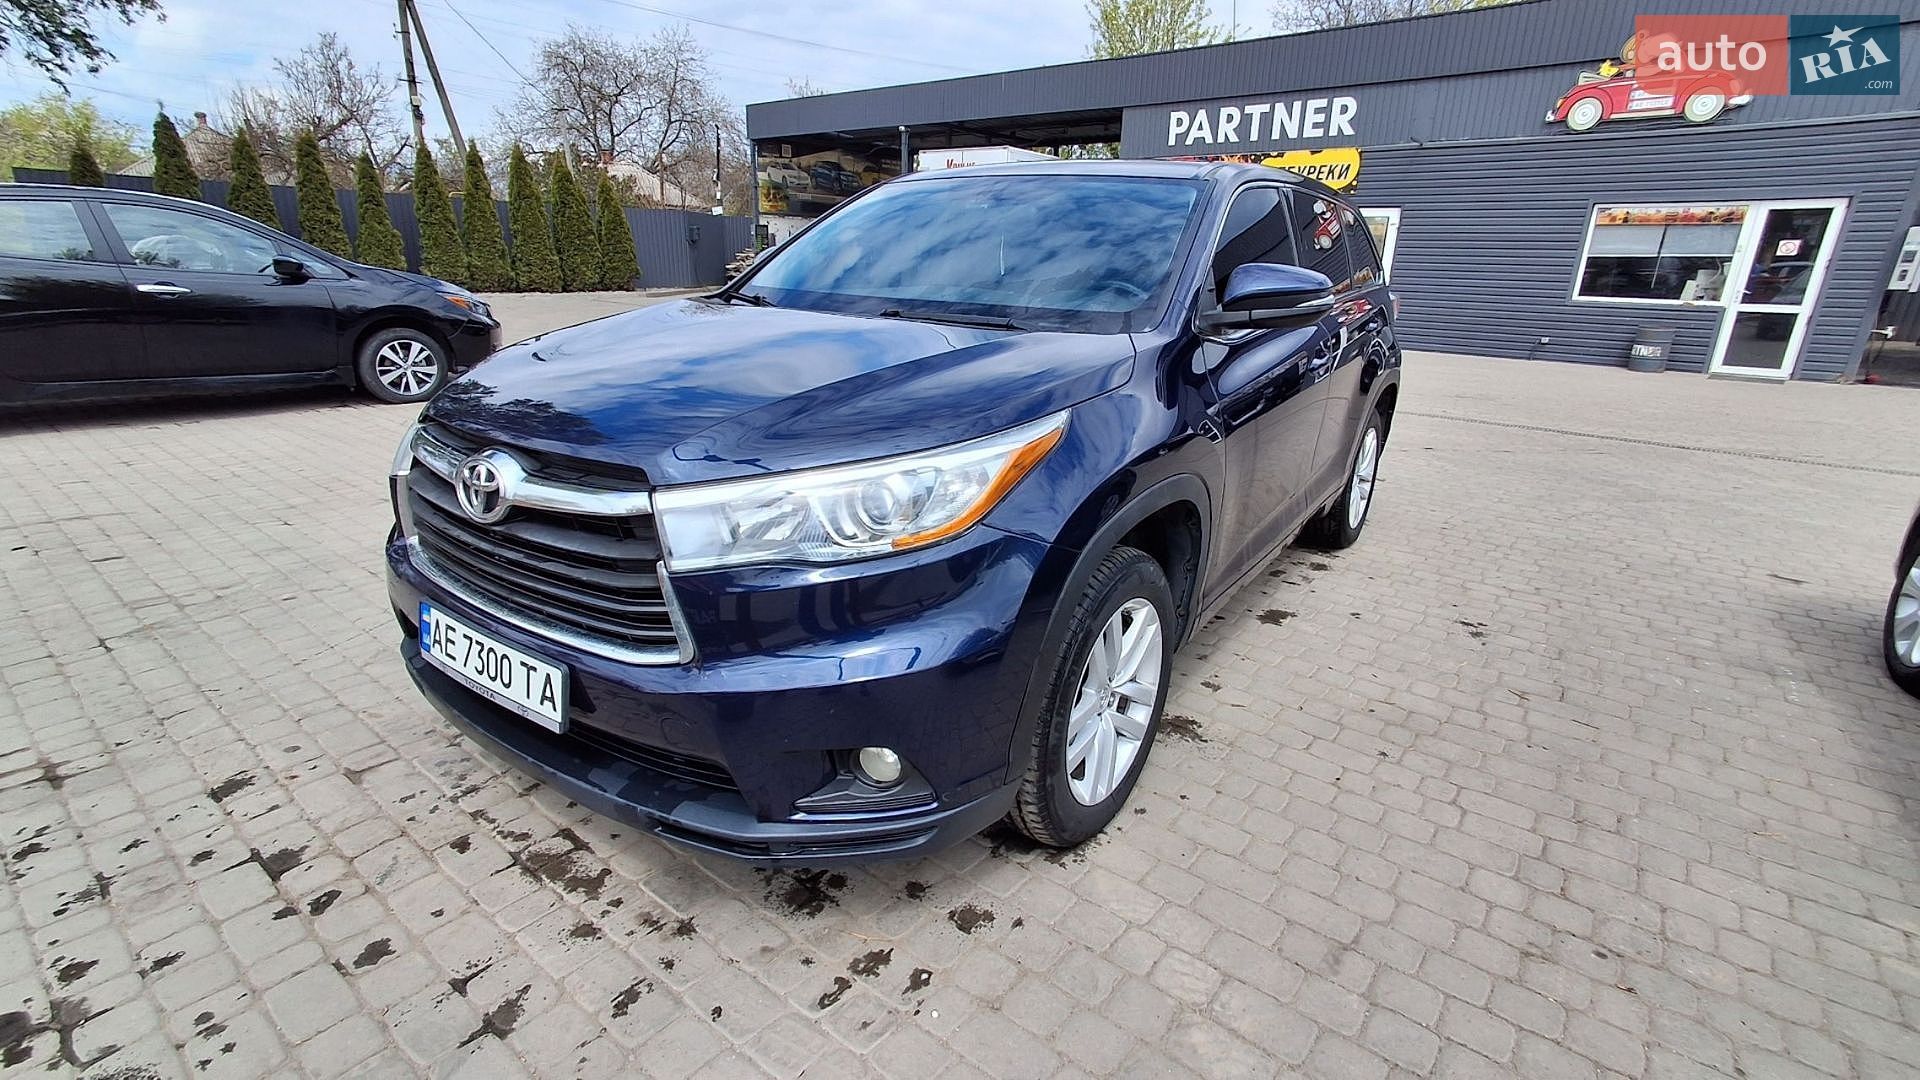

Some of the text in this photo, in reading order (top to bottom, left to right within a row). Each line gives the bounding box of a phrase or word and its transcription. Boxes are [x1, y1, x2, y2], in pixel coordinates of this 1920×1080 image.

[1167, 96, 1358, 146] PARTNER
[1283, 164, 1351, 181] УРЕКИ
[432, 618, 557, 713] AE 7300 TA
[464, 679, 496, 700] TOYOTA
